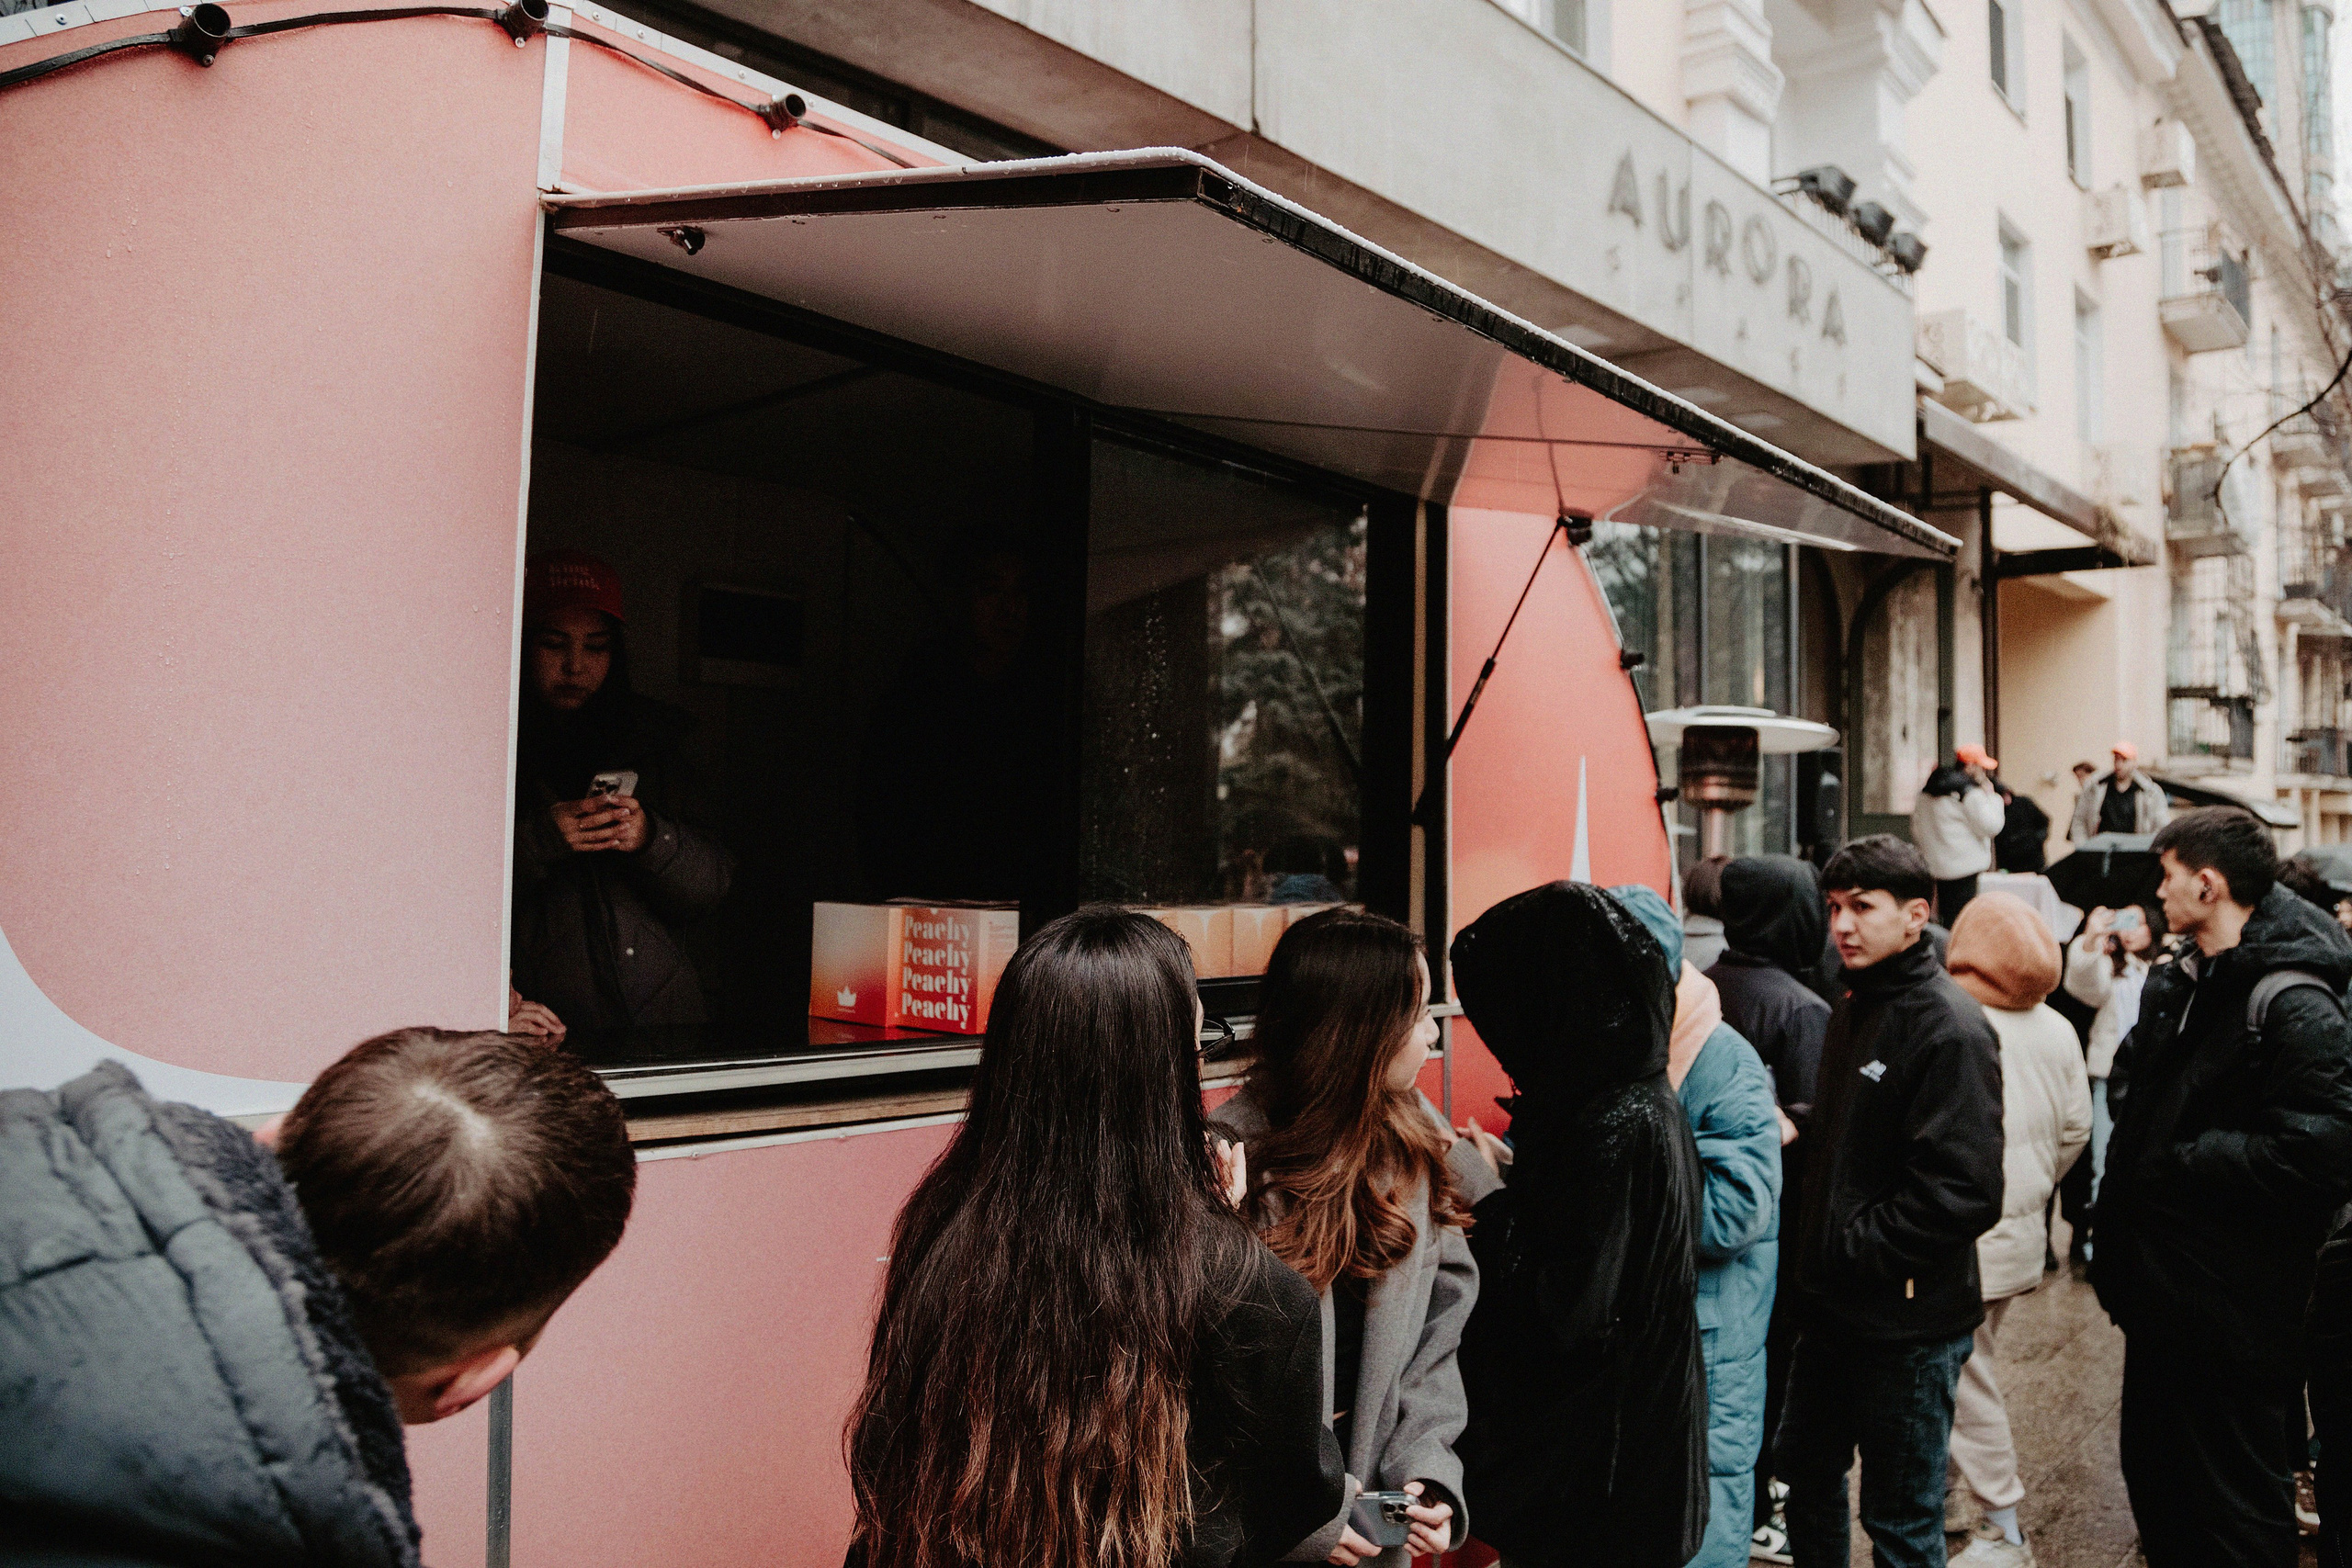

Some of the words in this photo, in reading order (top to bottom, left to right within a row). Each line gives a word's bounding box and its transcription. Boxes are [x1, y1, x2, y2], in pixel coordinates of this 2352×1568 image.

[1607, 145, 1848, 345] AURORA
[904, 916, 970, 948] Peachy
[903, 941, 970, 975] Peachy
[902, 967, 971, 1002] Peachy
[901, 992, 971, 1030] Peachy
